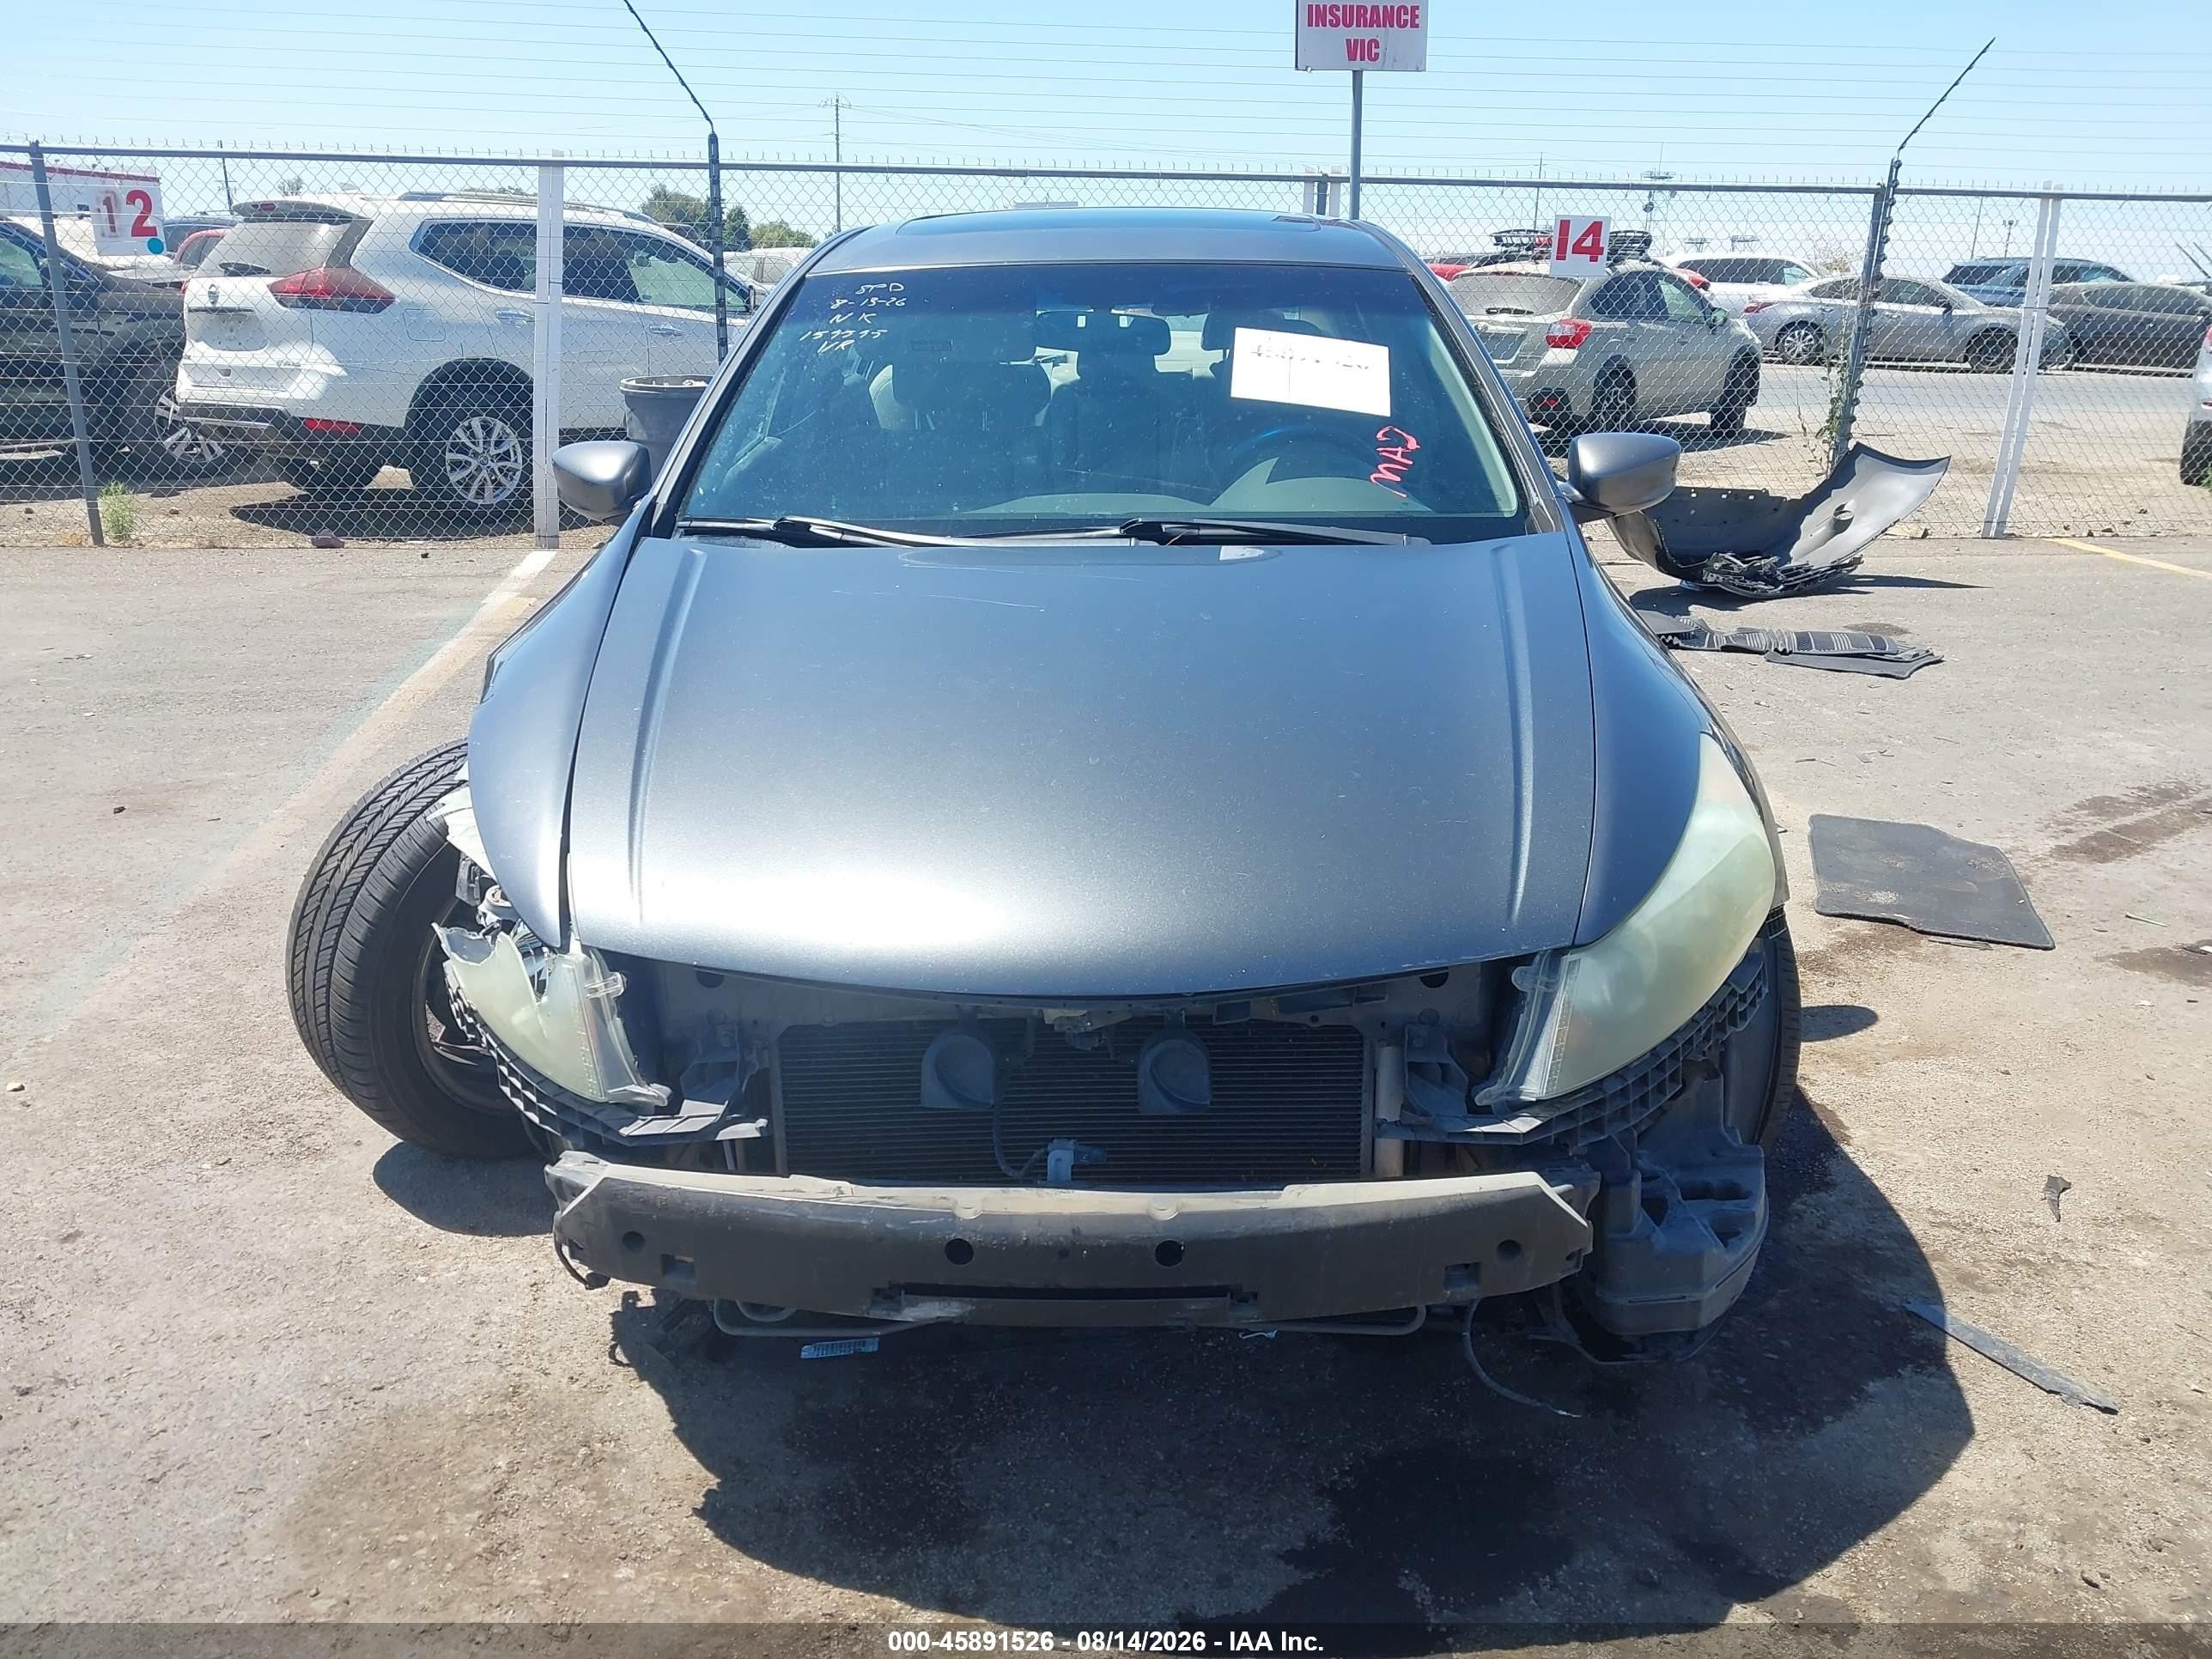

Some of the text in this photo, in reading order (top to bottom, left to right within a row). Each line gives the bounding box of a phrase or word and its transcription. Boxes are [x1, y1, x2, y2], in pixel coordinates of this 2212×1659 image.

[1307, 3, 1420, 29] INSURANCE
[1345, 38, 1381, 62] VIC
[100, 189, 158, 237] 12
[1555, 219, 1605, 263] 14
